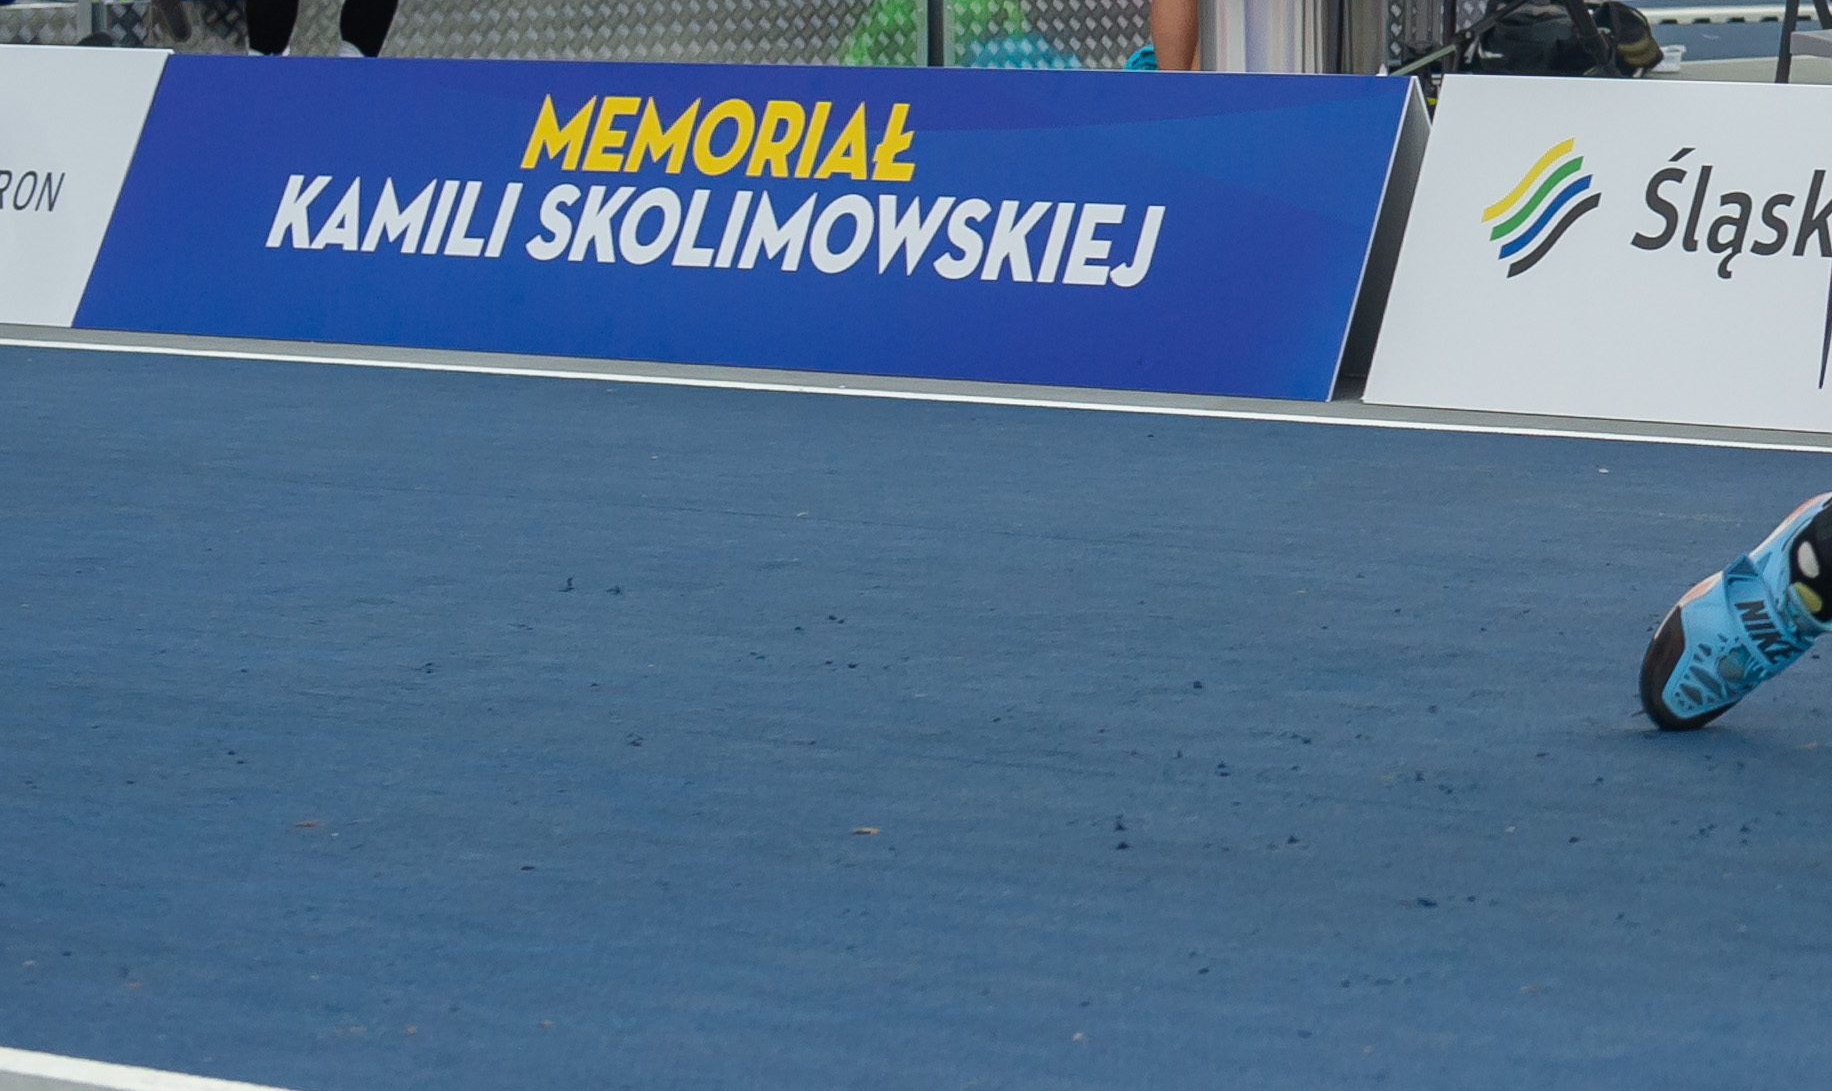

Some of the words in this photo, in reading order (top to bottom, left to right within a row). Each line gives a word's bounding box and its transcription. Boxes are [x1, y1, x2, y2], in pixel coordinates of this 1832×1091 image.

[520, 93, 917, 182] MEMORIAŁ
[265, 174, 524, 259] KAMILI
[525, 184, 1167, 289] SKOLIMOWSKIEJ
